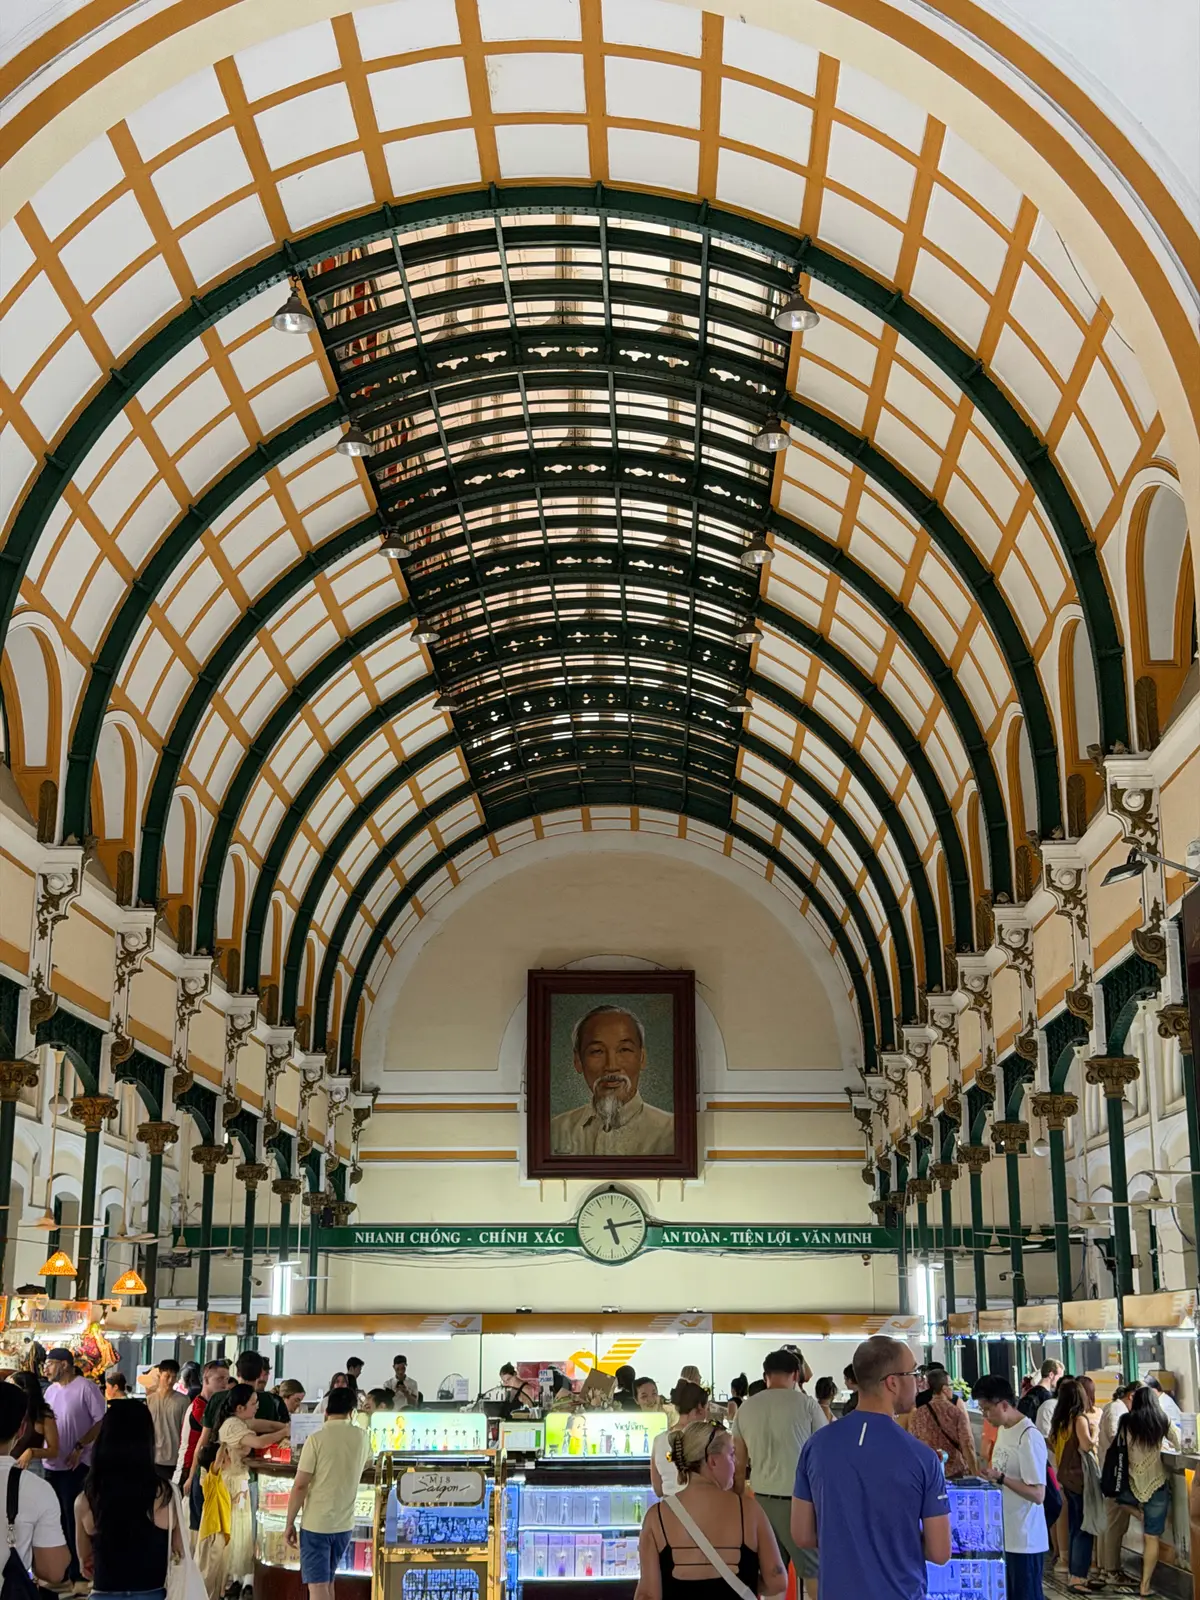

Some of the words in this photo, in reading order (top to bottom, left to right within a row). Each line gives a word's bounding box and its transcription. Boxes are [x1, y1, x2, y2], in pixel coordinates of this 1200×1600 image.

[355, 1231, 405, 1244] NHANH
[409, 1228, 461, 1244] CHÓNG
[478, 1228, 528, 1244] CHÍNH
[533, 1228, 565, 1244] XÁC
[661, 1231, 680, 1244] AN
[682, 1228, 721, 1244] TOÀN
[730, 1228, 764, 1246] TIỆN
[767, 1230, 791, 1247] LỢI
[801, 1229, 831, 1244] VĂN
[834, 1231, 872, 1244] MINH
